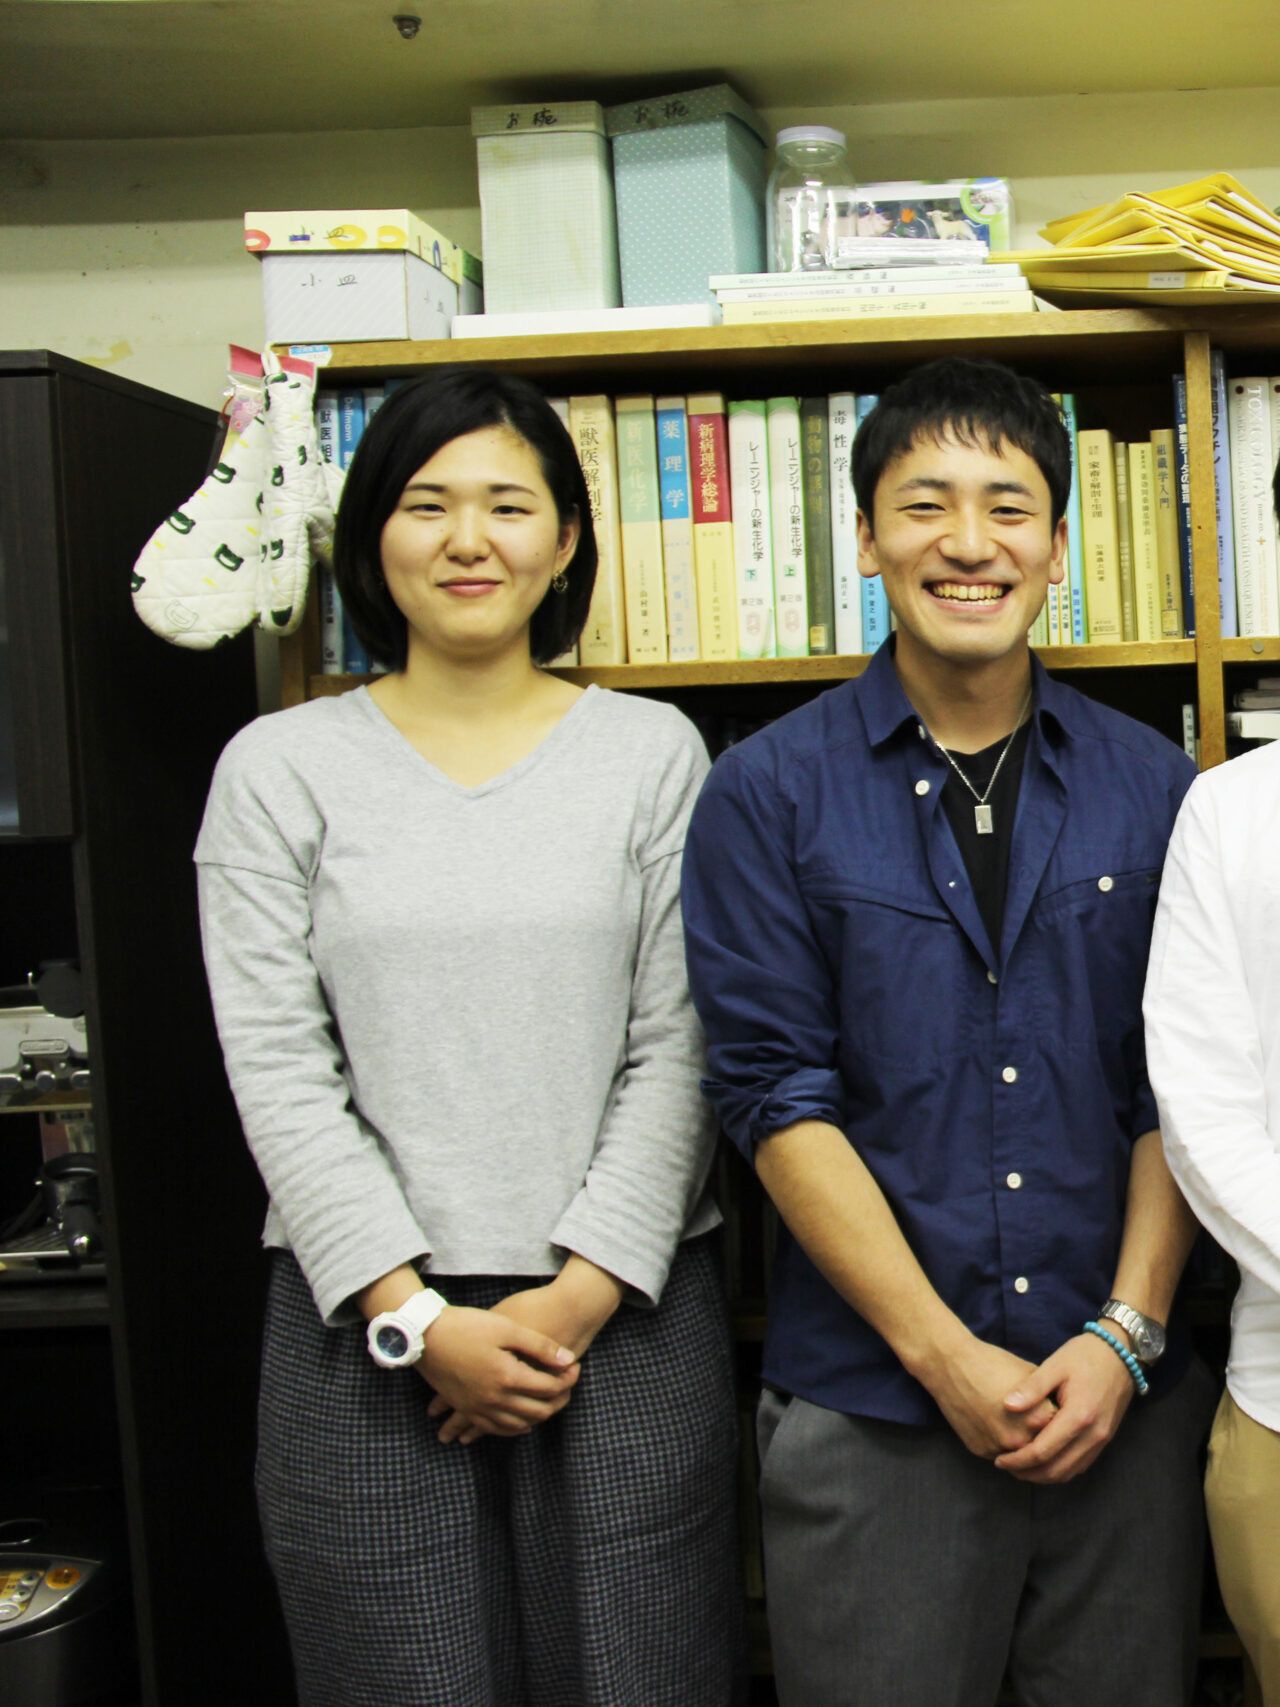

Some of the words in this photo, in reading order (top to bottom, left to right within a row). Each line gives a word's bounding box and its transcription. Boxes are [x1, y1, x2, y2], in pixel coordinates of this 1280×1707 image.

[626, 420, 648, 513] 新医化学
[662, 420, 685, 509] 薬理学
[699, 423, 719, 513] 新病理学総論
[834, 410, 848, 472] 毒性学
[1156, 444, 1170, 510] 組織学入門
[1247, 384, 1266, 500] TOXICOLOGY
[748, 441, 764, 562] レーニンジャーの新生化学
[787, 438, 803, 559] レーニンジャーの新生化学
[745, 568, 756, 580] 下
[784, 566, 795, 578] 上
